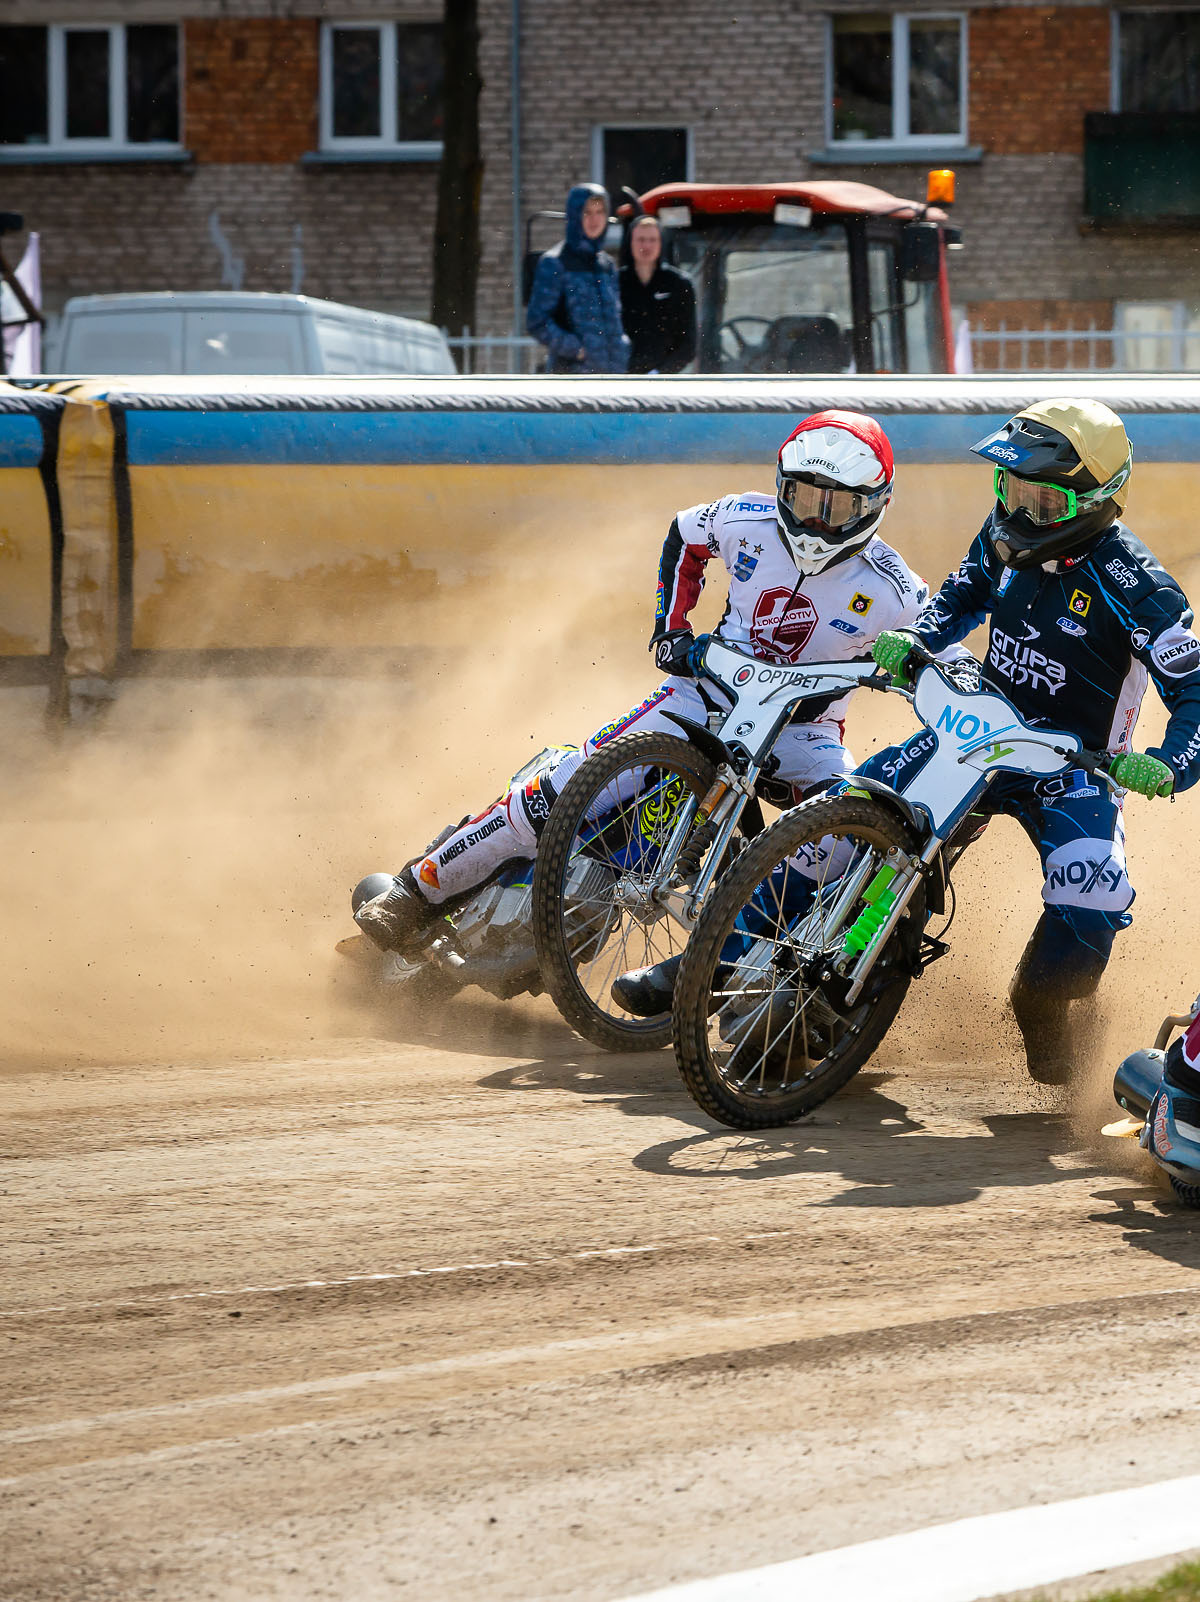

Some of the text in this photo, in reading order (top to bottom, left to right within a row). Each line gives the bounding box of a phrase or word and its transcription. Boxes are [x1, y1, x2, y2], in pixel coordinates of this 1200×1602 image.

[806, 458, 836, 471] SHOEI
[871, 545, 912, 594] Interio
[757, 611, 812, 627] LOKOMOTIV
[1159, 639, 1200, 663] HEKTO
[758, 669, 823, 690] OPTIBET
[881, 734, 935, 778] Saletr
[438, 815, 507, 868] AMBER STUDIOS
